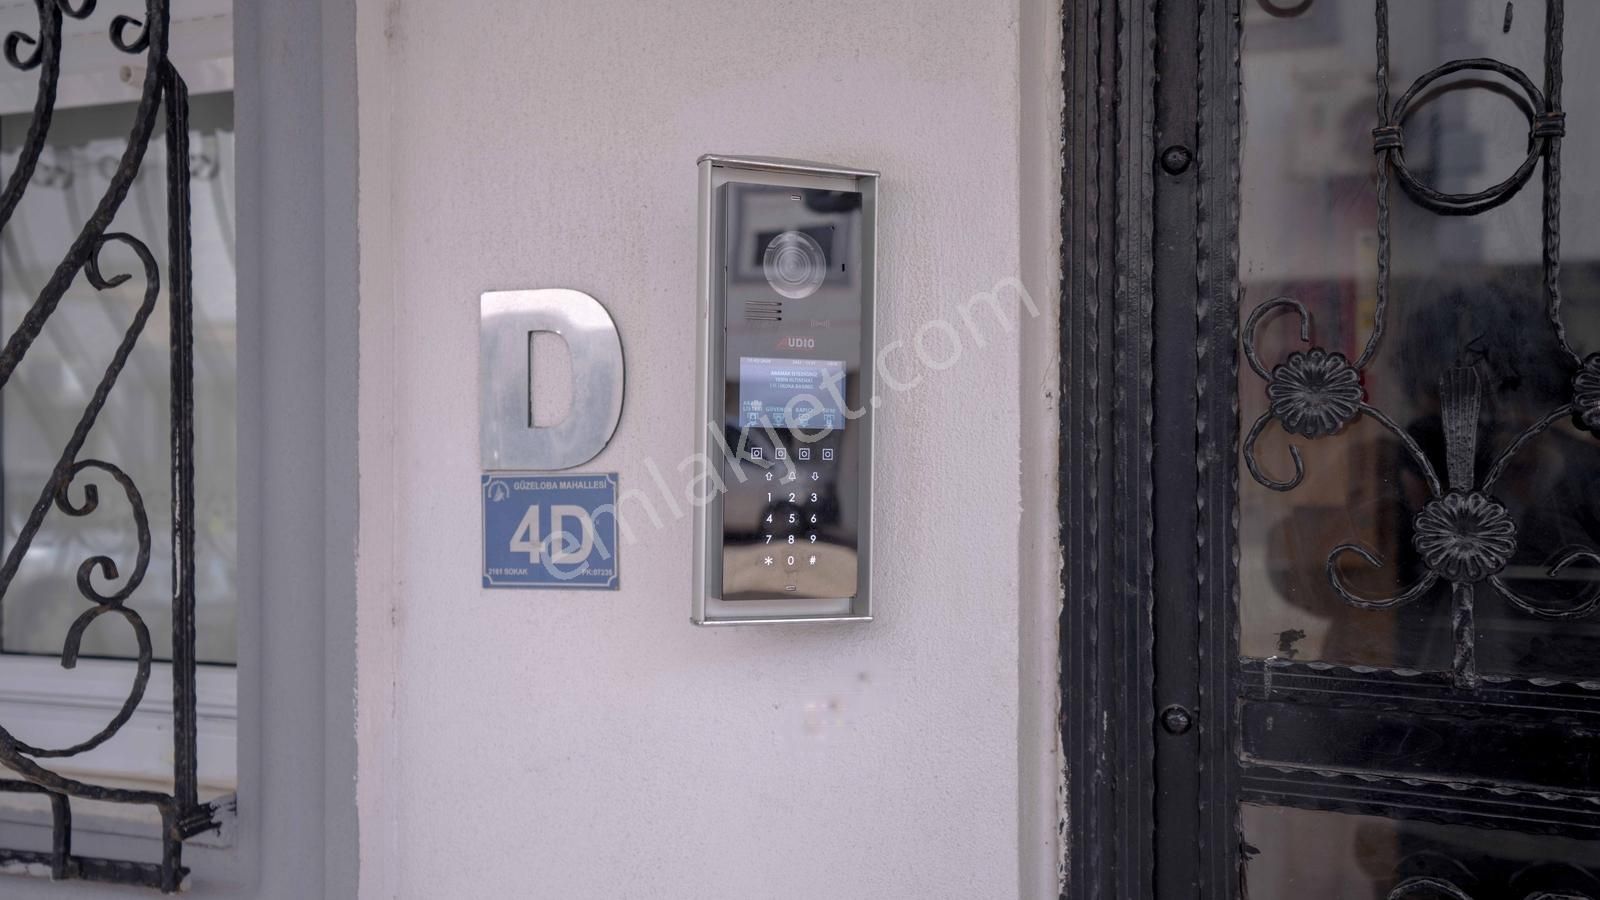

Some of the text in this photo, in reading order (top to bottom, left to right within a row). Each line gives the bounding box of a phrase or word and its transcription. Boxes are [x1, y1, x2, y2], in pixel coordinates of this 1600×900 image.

[480, 288, 626, 471] D
[513, 479, 607, 490] GÜZELOBA MAHALLESİ
[767, 493, 817, 503] 1 2 3
[766, 514, 817, 523] 4 5 6
[509, 504, 594, 564] 4D
[766, 534, 817, 545] 7 8 9
[788, 556, 795, 566] 0
[503, 567, 528, 576] SOKAK
